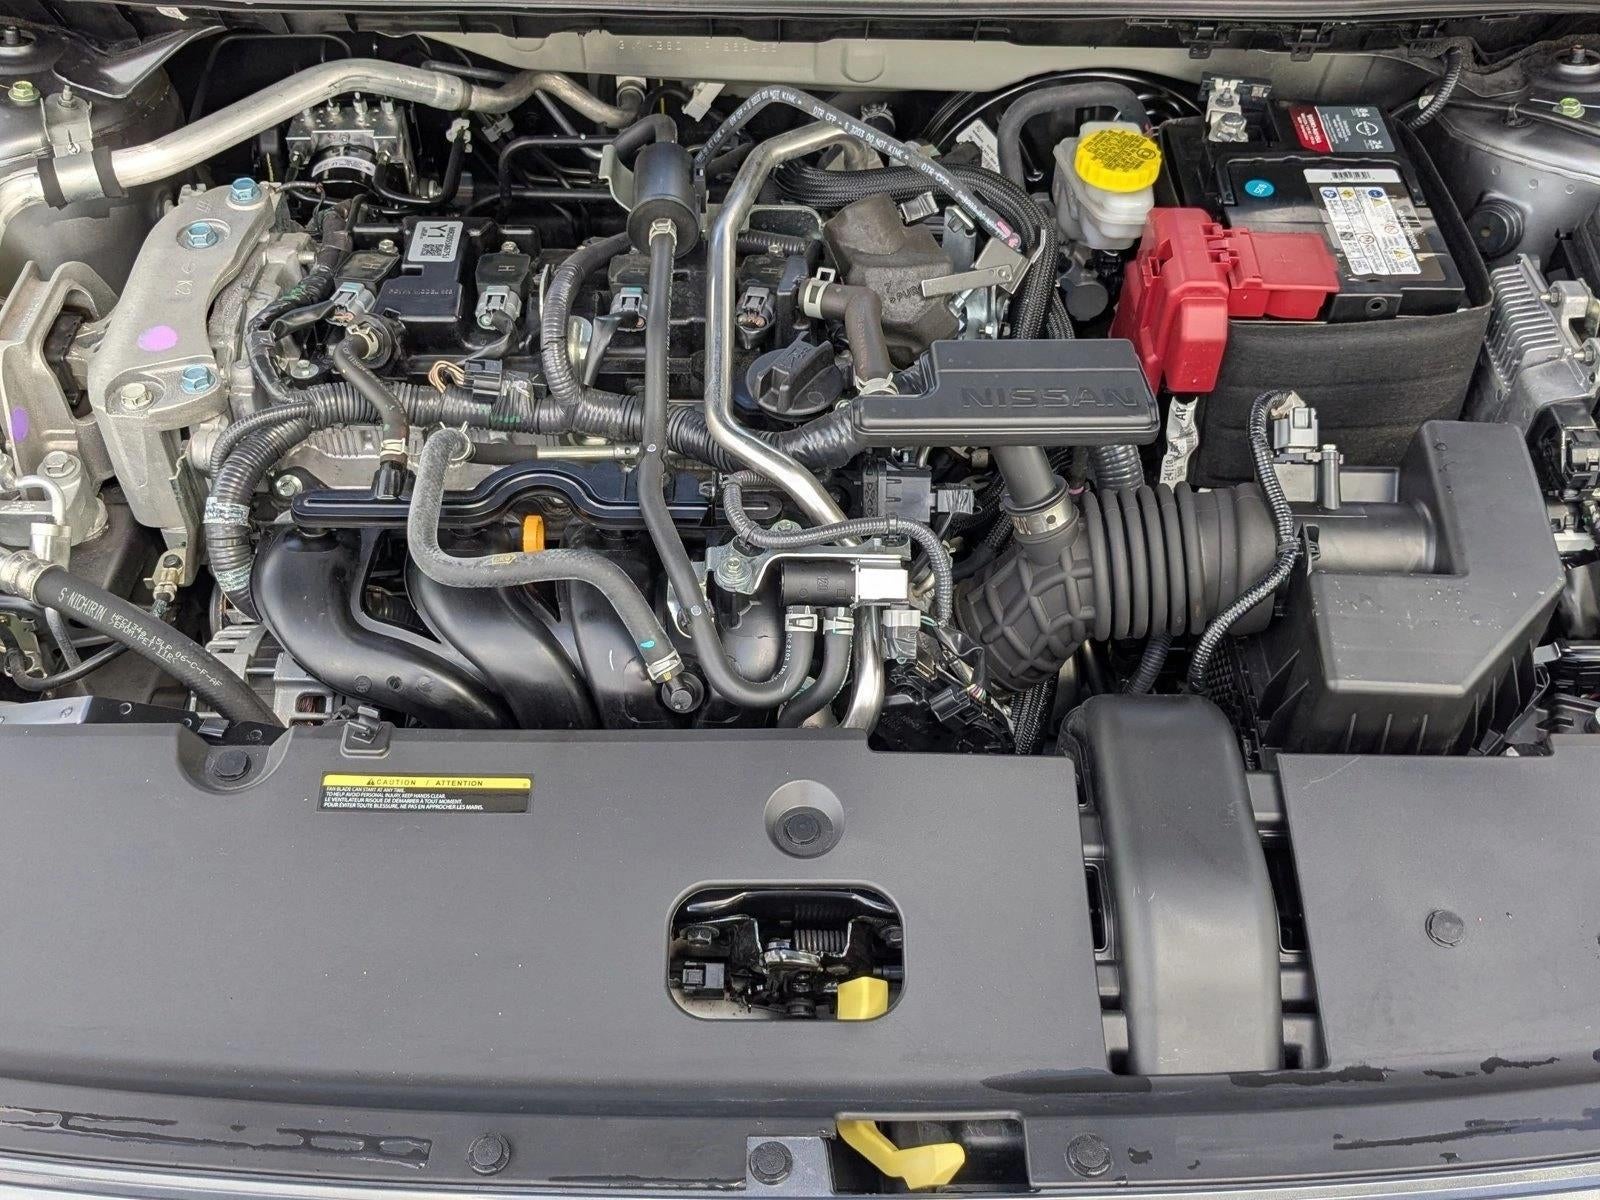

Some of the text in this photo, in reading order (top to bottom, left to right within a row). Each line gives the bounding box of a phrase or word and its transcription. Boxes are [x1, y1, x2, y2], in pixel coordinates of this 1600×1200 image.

[921, 162, 935, 176] DTR
[427, 224, 448, 238] Y1
[962, 387, 1139, 408] NISSAN
[376, 778, 416, 786] CAUTION
[435, 779, 483, 787] ATTENTION
